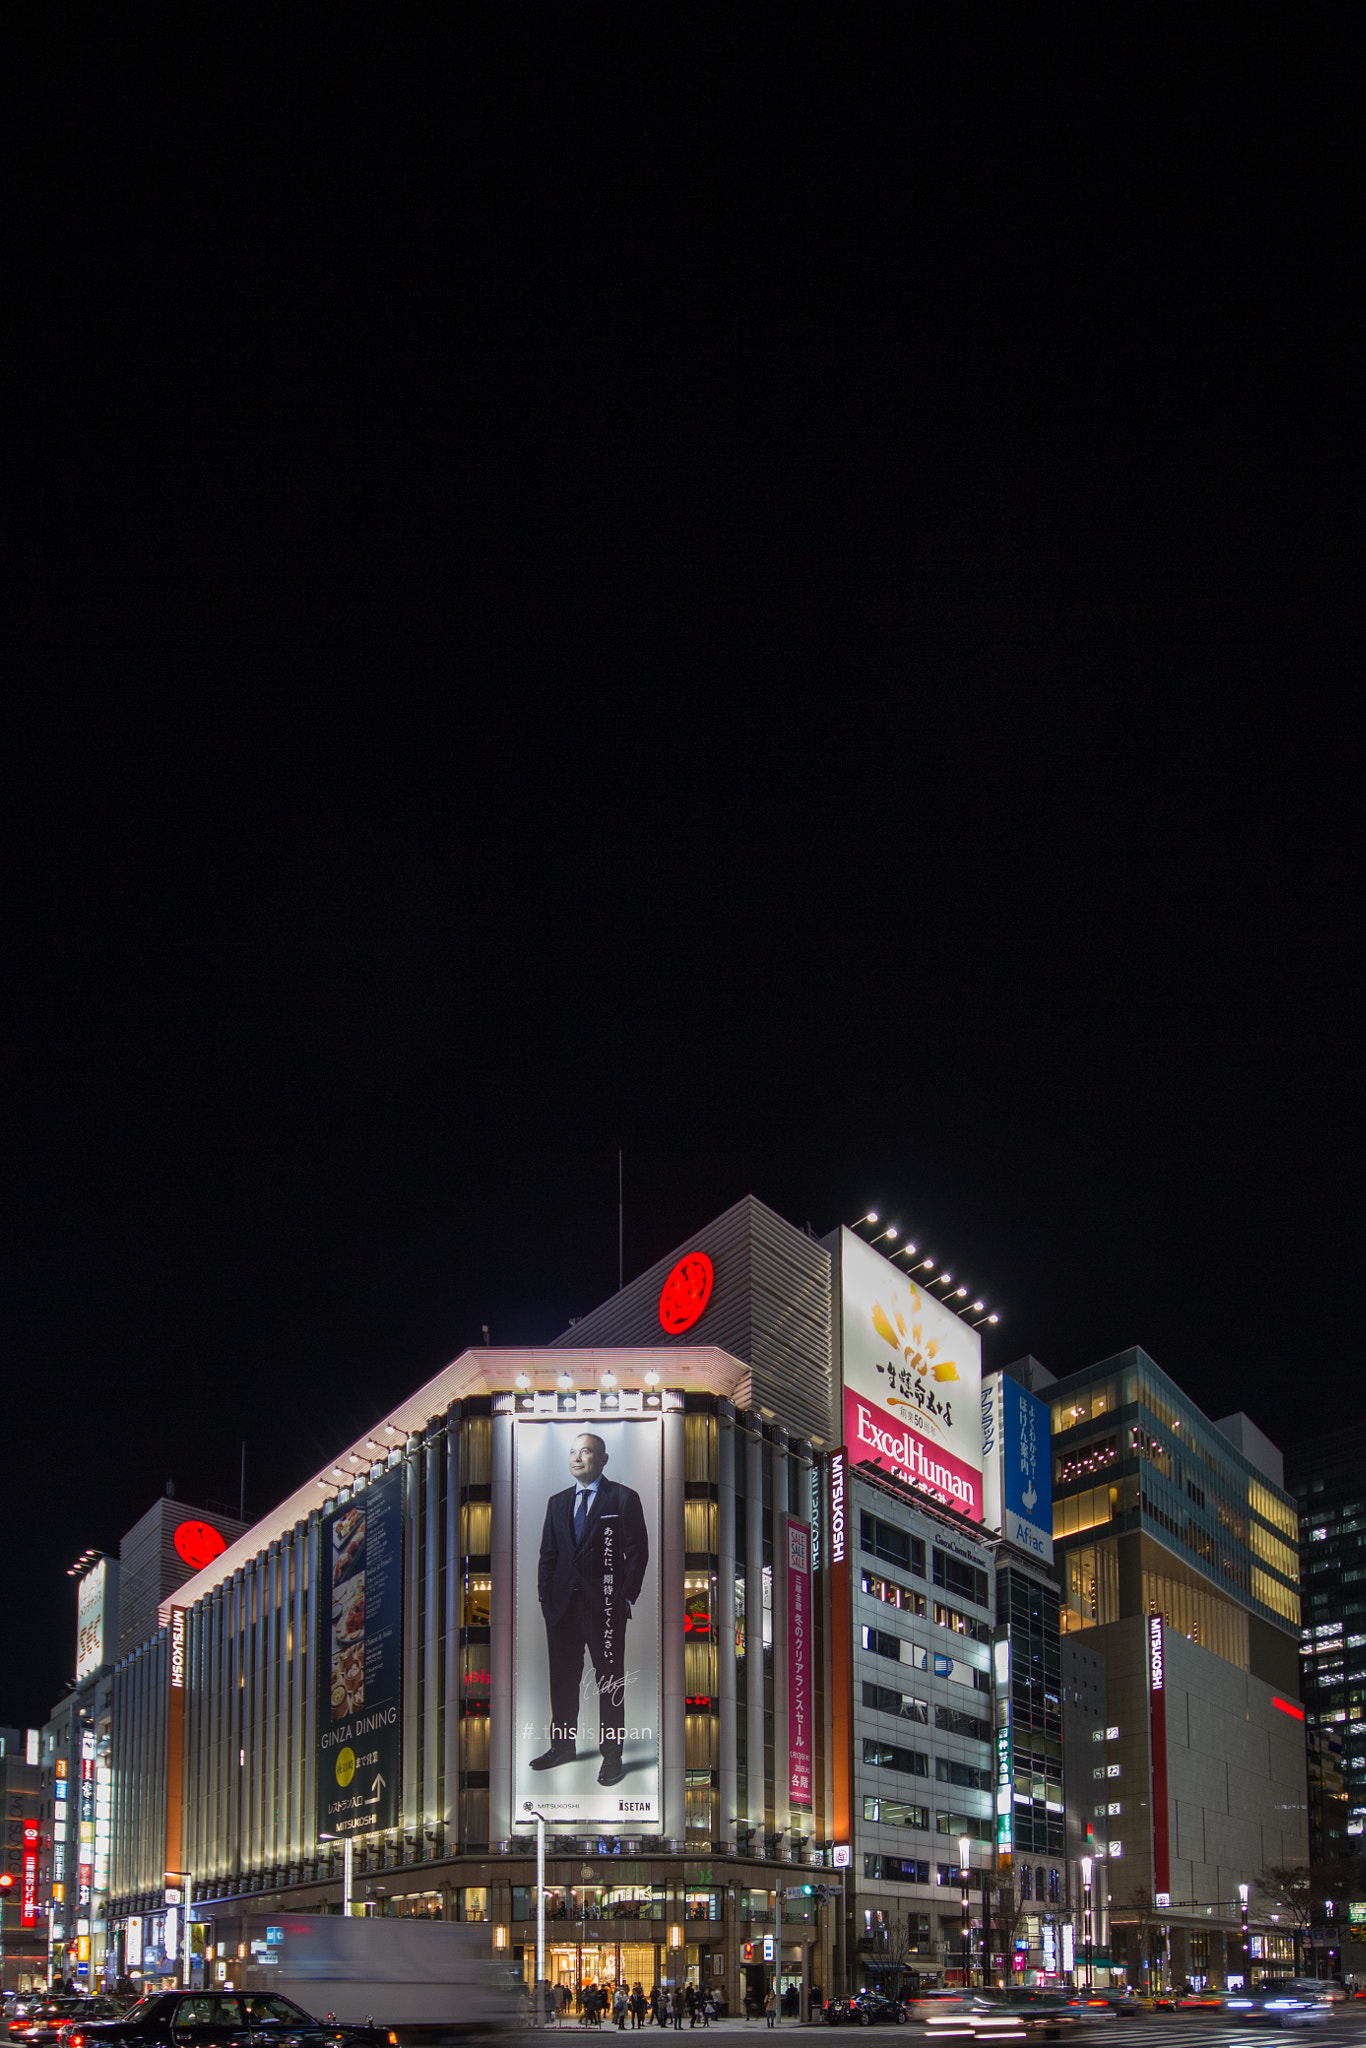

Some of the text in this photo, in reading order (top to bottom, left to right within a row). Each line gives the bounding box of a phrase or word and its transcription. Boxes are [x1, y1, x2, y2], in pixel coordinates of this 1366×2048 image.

[856, 1403, 975, 1507] ExcelHuman
[832, 1454, 845, 1563] MITSUKOSHI
[791, 1531, 805, 1548] SALE
[791, 1543, 805, 1559] SALE
[1016, 1523, 1044, 1554] Aflac
[791, 1555, 805, 1571] SALE
[603, 1526, 614, 1664] あなたに、期待してください。
[171, 1609, 184, 1688] MITSUKOSHI
[1151, 1618, 1163, 1690] MITSUKOSHI
[794, 1613, 804, 1747] 冬のクリアランスセール
[321, 1706, 397, 1749] GINZA DINING
[581, 1722, 595, 1740] is
[599, 1722, 653, 1744] japan
[791, 1774, 809, 1789] 各階
[328, 1795, 364, 1815] レストラン入口
[335, 1814, 378, 1833] MITSUKOSHI
